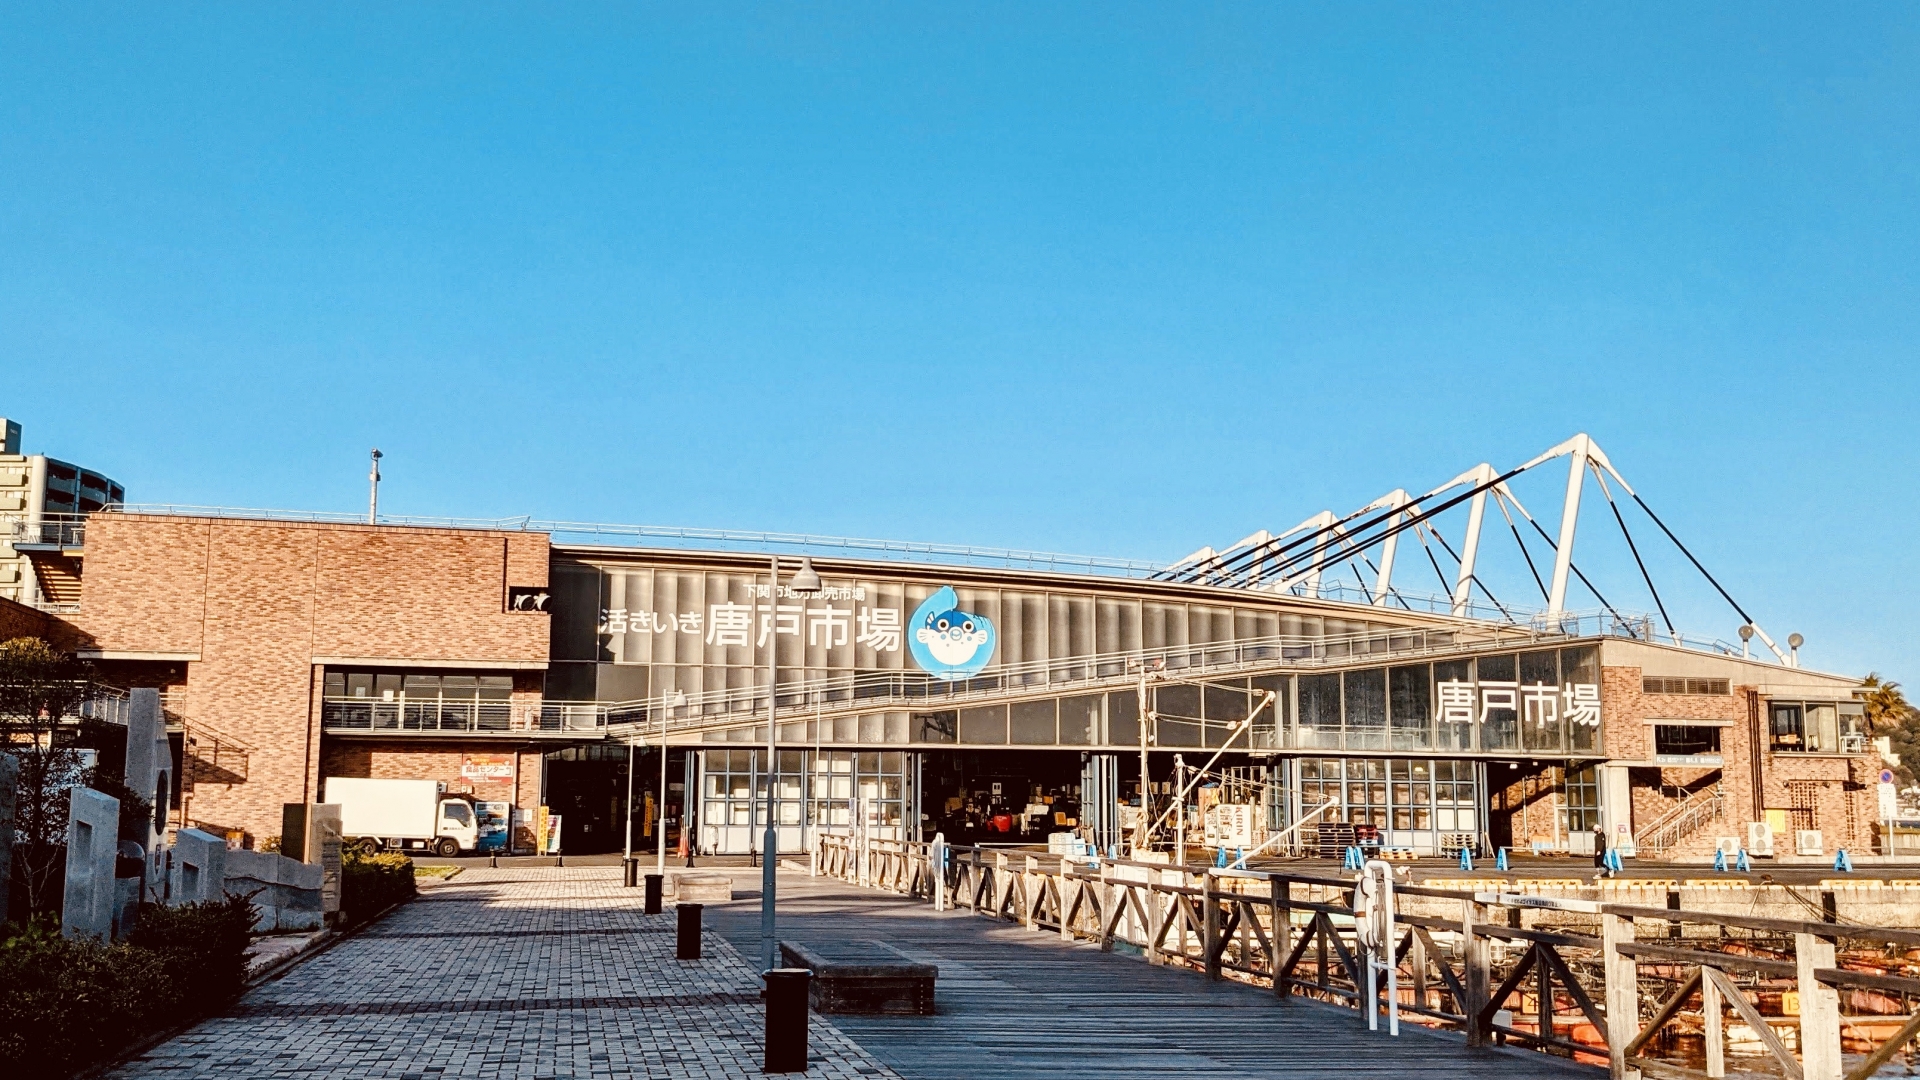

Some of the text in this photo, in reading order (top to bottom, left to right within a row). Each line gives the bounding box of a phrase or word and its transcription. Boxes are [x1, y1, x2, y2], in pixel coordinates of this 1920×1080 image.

[600, 601, 901, 652] 活きいき 唐戸市場
[1435, 678, 1601, 729] 唐戸市場
[1235, 806, 1243, 835] KIRIN
